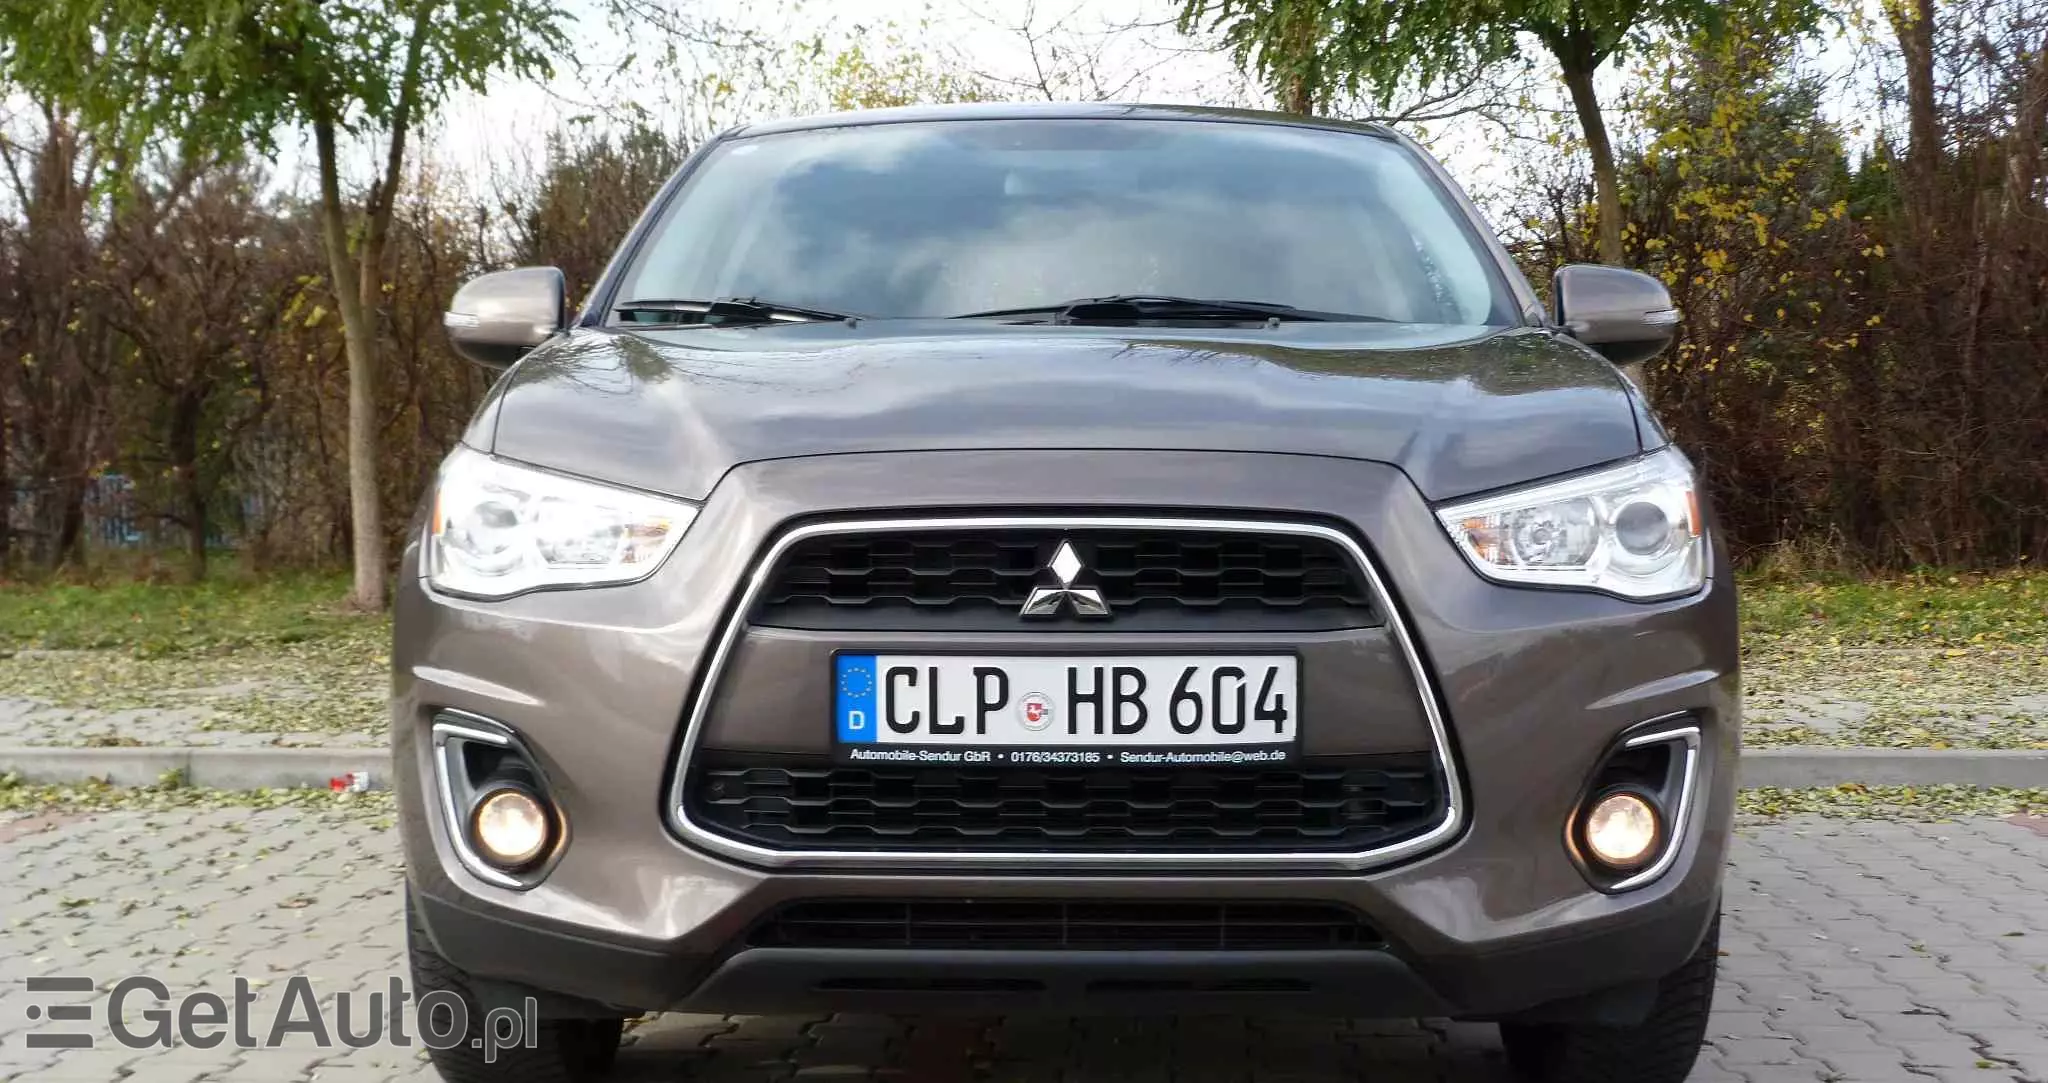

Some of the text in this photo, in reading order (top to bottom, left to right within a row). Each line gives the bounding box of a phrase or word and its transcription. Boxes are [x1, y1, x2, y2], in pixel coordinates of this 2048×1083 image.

[885, 666, 1289, 734] CLP HB 604
[849, 711, 865, 730] D
[850, 748, 1286, 763] Automobile-Sendur GbR 0176/34373185 Sendur-Automobile@web.de
